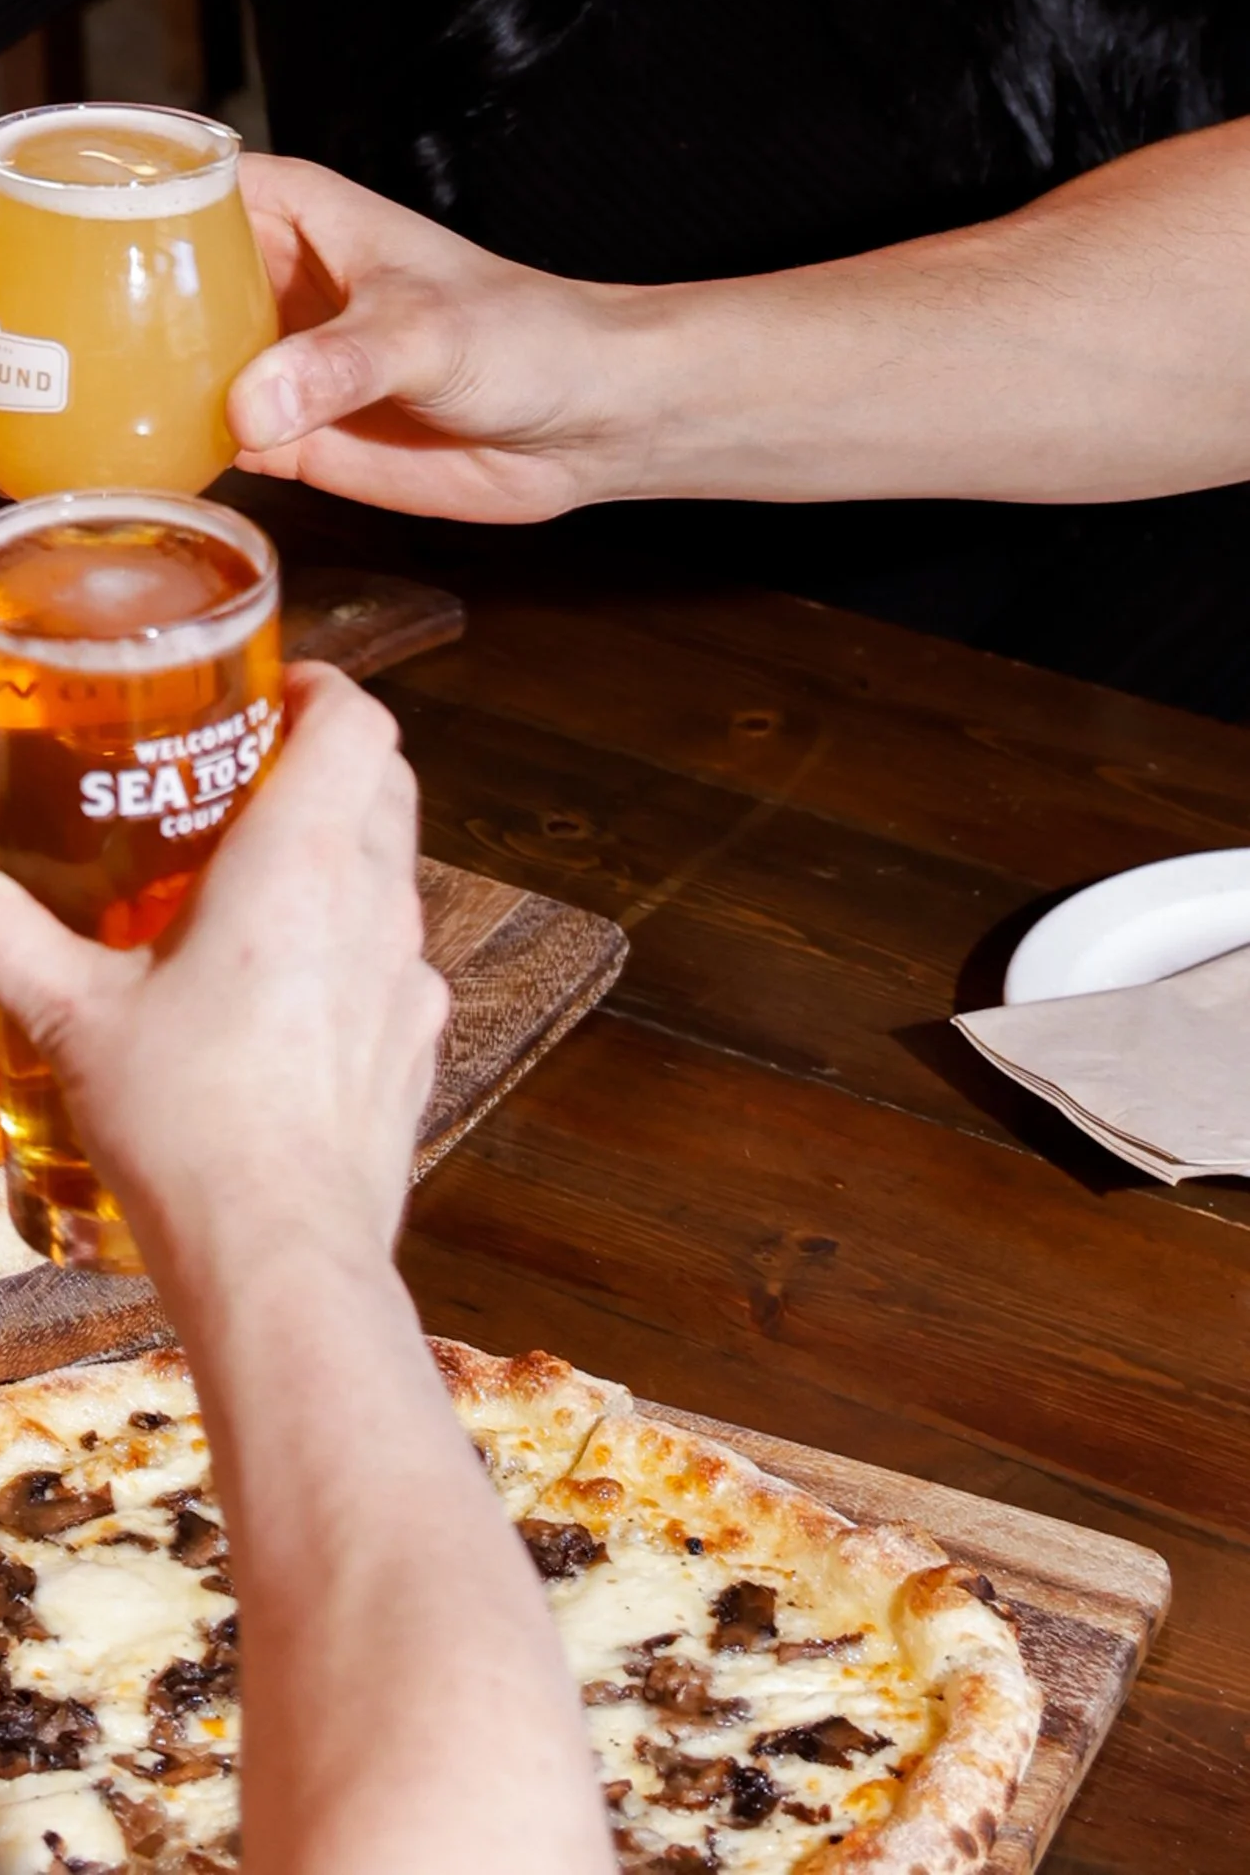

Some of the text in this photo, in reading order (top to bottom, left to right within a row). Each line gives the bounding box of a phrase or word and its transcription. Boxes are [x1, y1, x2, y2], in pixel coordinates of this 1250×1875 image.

[134, 697, 270, 763] WELCOME TO
[79, 765, 190, 817] SEA
[194, 756, 237, 794] TO
[160, 799, 234, 838] COUN
